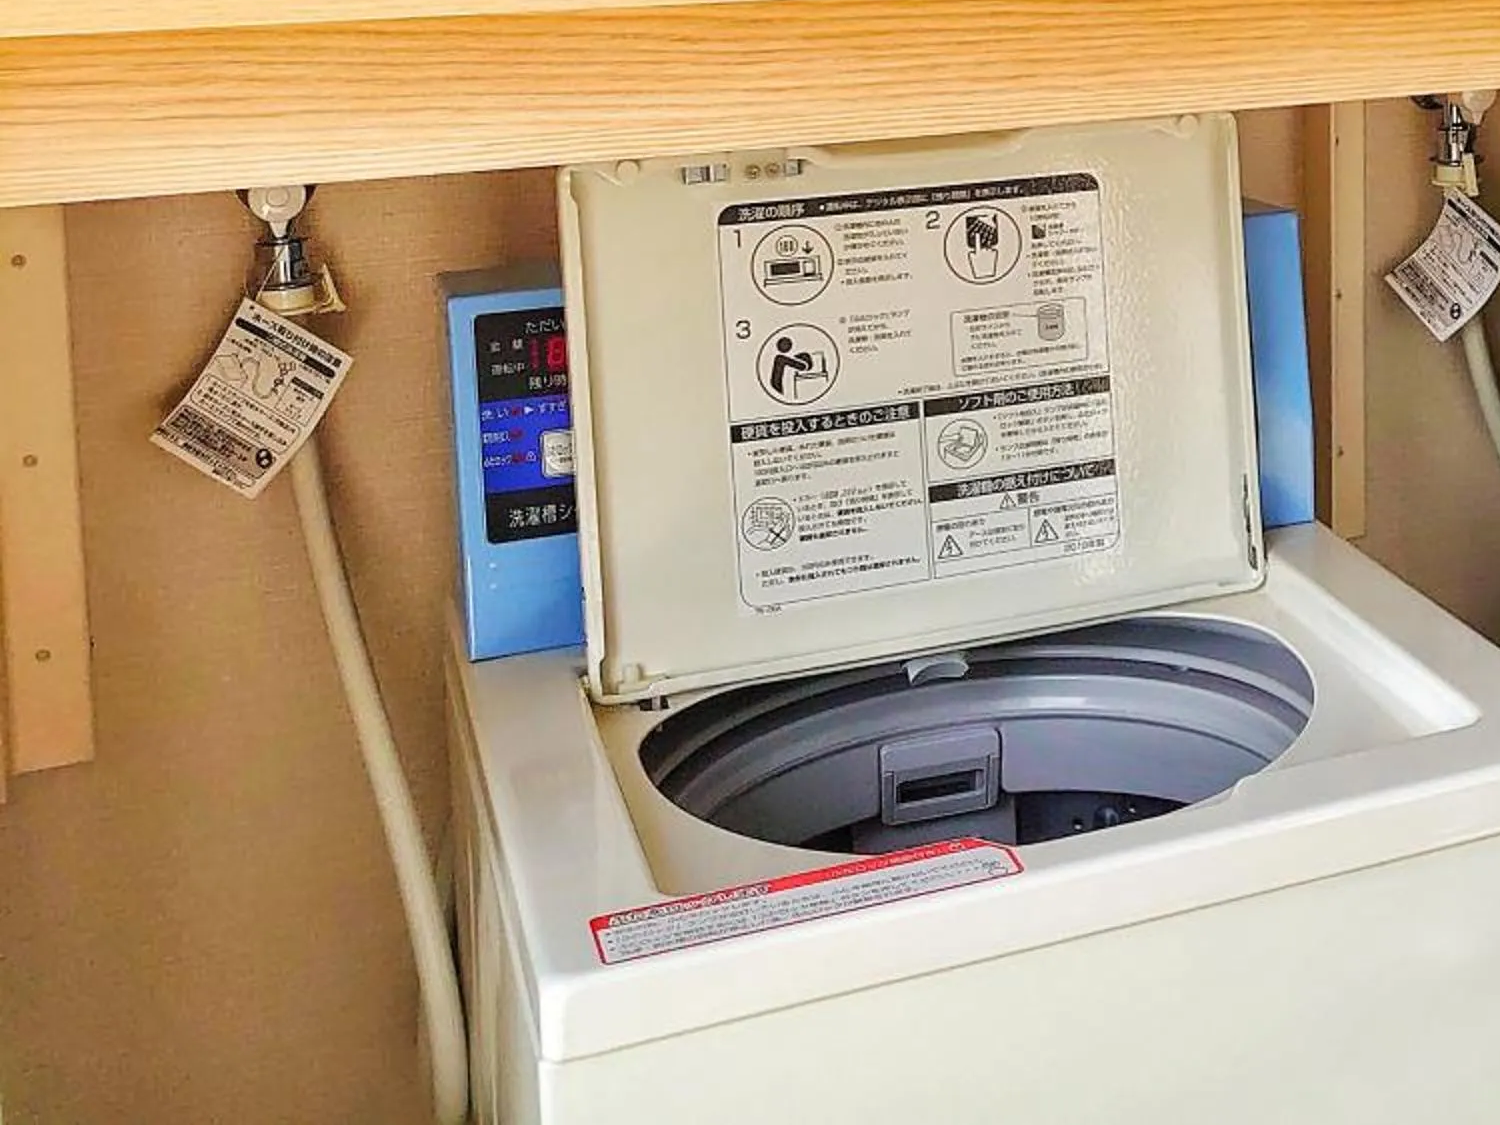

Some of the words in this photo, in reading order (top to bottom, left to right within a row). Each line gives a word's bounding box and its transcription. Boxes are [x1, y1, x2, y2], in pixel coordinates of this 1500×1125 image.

[737, 202, 805, 222] 洗濯の順序
[733, 230, 742, 248] 1
[924, 212, 941, 230] 2
[525, 318, 564, 335] ただい
[735, 320, 752, 339] 3
[491, 362, 525, 376] 運転中
[740, 402, 909, 441] 硬貨を投入するときのご注意
[1017, 491, 1040, 505] 警告
[508, 504, 578, 529] 洗濯槽シ
